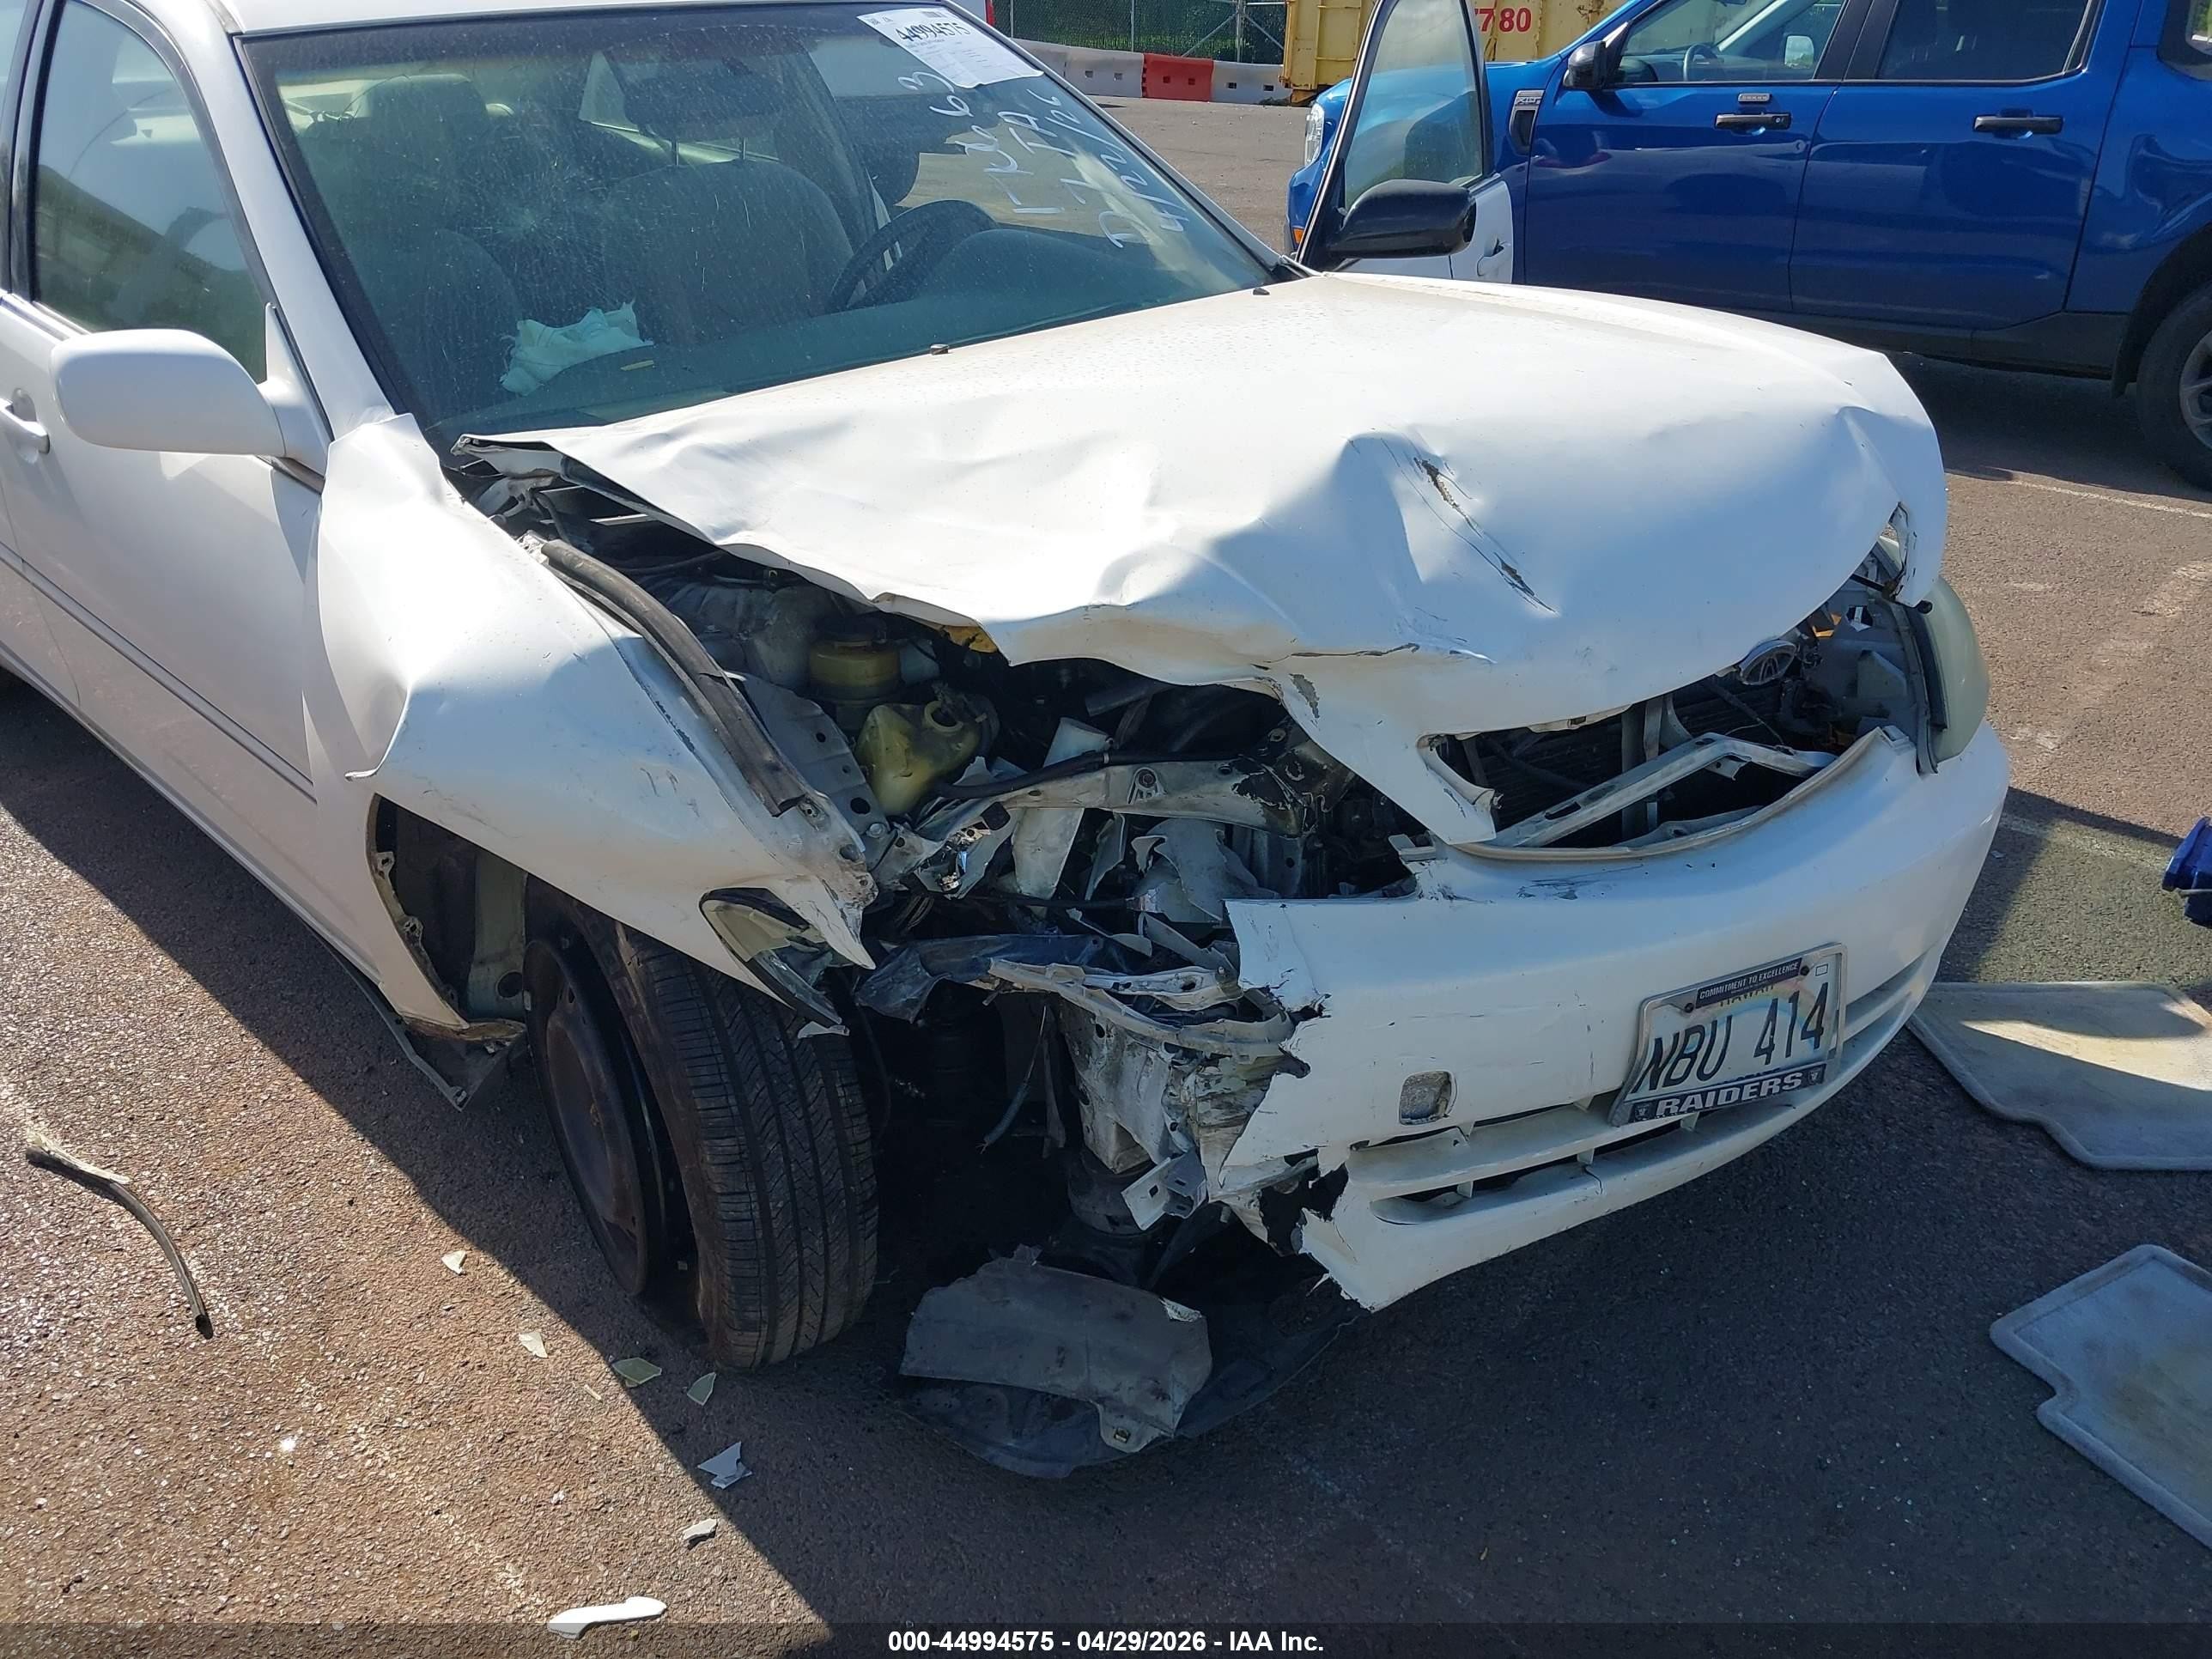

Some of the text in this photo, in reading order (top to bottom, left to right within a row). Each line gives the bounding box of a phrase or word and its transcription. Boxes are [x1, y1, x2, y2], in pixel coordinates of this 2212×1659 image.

[896, 21, 970, 42] 44994575
[1474, 7, 1532, 33] 780
[1699, 978, 1747, 1000] COMMITMENT
[1747, 975, 1758, 985] TO
[1758, 961, 1799, 982] EXCELLENCE
[1633, 981, 1829, 1094] NBU 414
[1656, 1071, 1803, 1116] RAIDERS
